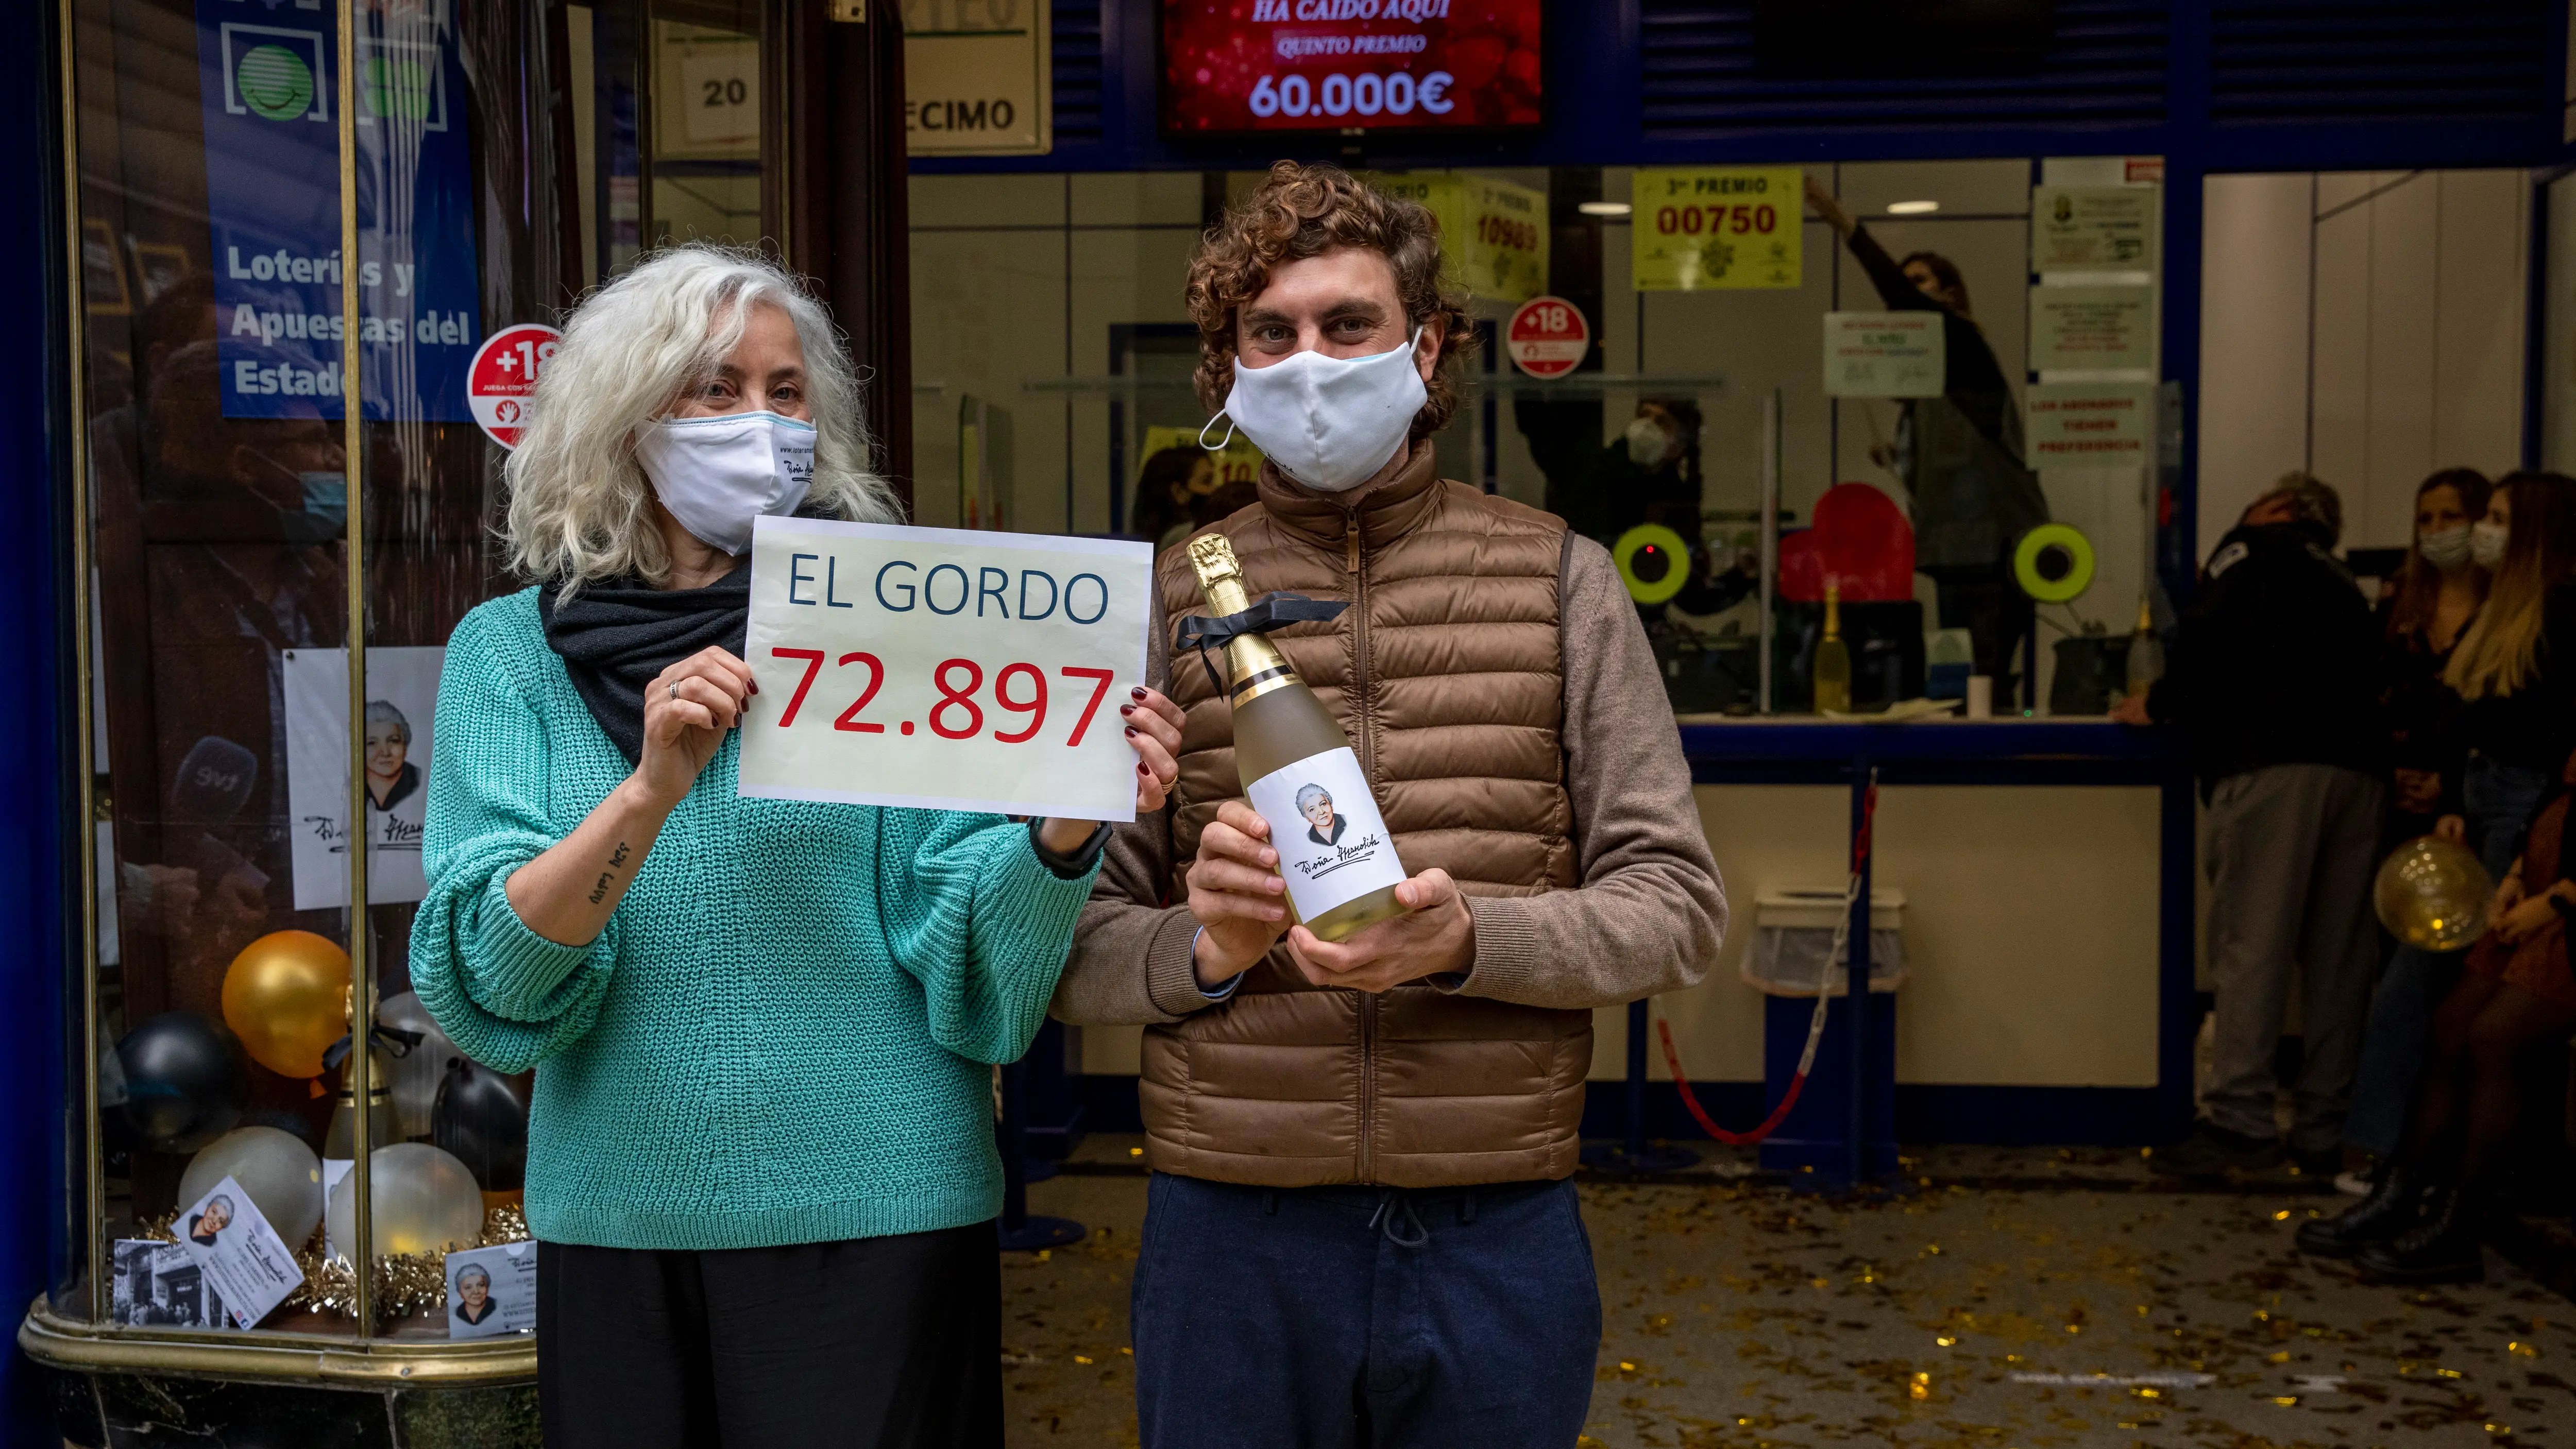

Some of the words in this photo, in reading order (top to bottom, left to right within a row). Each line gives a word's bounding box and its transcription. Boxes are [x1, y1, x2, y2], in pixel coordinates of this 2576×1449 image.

[1251, 0, 1290, 21] HA
[1277, 36, 1351, 59] QUINTO
[1353, 35, 1427, 54] PREMIO
[703, 79, 746, 106] 20
[1249, 71, 1454, 117] 60.000€
[1696, 178, 1768, 194] PREMIO
[1657, 204, 1775, 234] 00750
[228, 246, 382, 286] Loterís
[394, 263, 415, 297] y
[231, 303, 405, 346] Apuesas
[417, 310, 469, 345] del
[1524, 305, 1568, 332] +18
[235, 361, 362, 396] Estad
[2038, 439, 2140, 452] PREFERENCIA
[789, 553, 853, 608] EL
[875, 560, 1109, 625] GORDO
[771, 647, 1114, 747] 72.897
